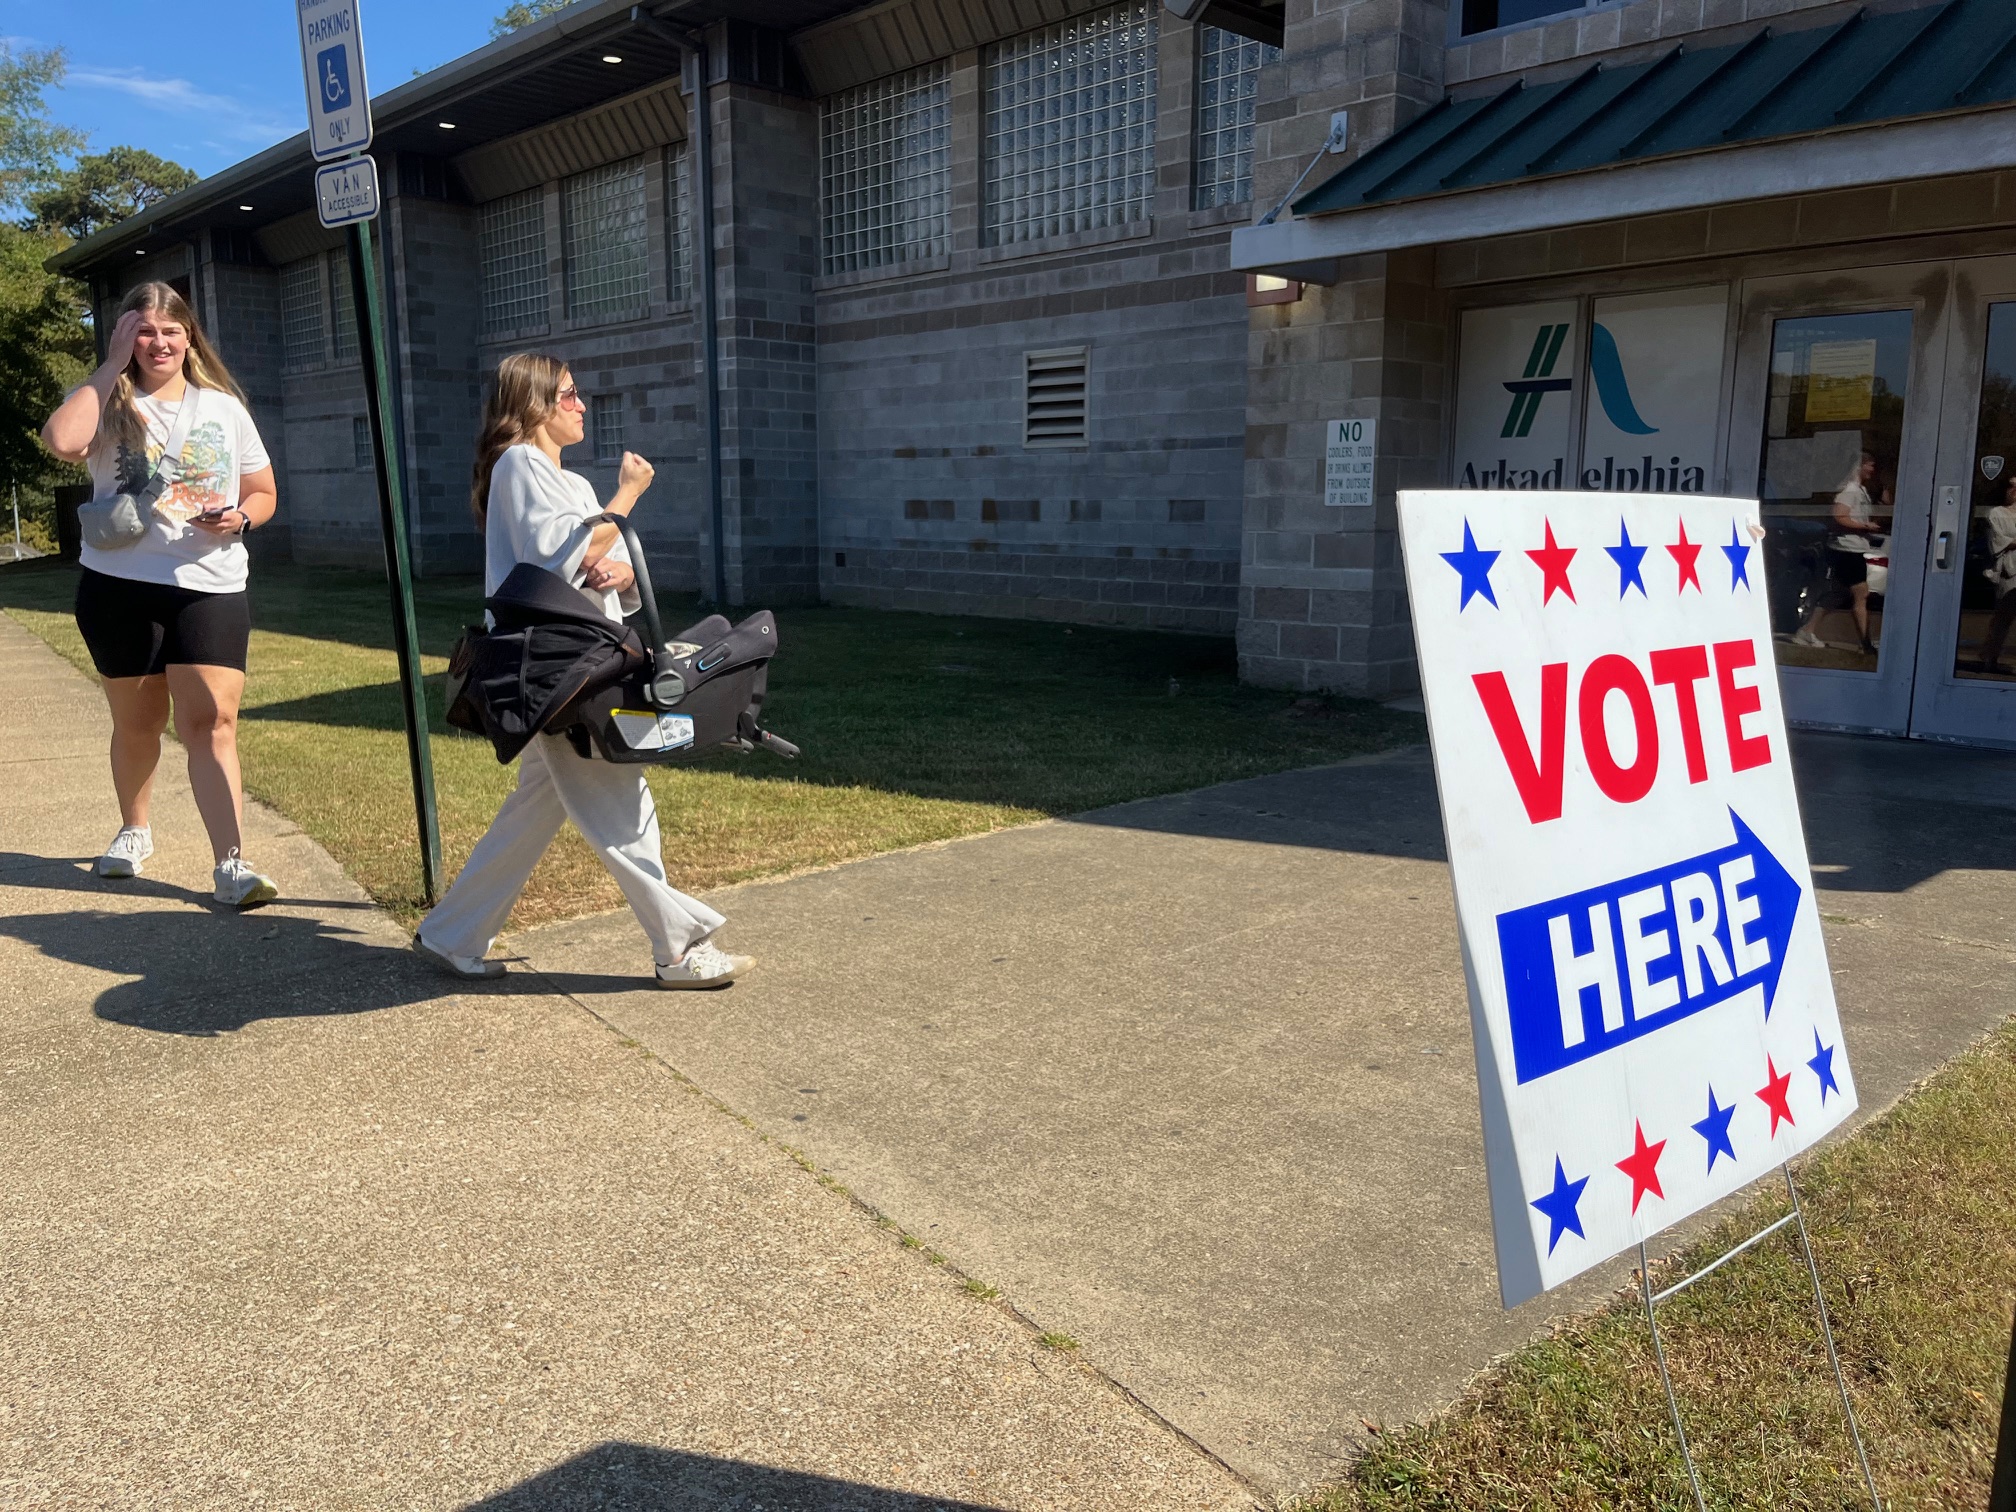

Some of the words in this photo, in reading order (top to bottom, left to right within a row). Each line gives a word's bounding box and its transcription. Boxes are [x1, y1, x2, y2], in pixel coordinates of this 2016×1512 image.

[308, 9, 351, 45] PARKING
[329, 116, 351, 140] ONLY
[333, 172, 360, 195] VAN
[328, 192, 369, 213] ACCESSIBLE
[1339, 421, 1362, 442] NO
[1357, 446, 1372, 457] FOOD
[1327, 478, 1343, 489] FROM
[1346, 478, 1371, 489] OUTSIDE
[1329, 493, 1337, 503] OF
[1340, 492, 1368, 503] BUILDING
[1471, 639, 1772, 824] VOTE
[1547, 853, 1771, 1050] HERE
